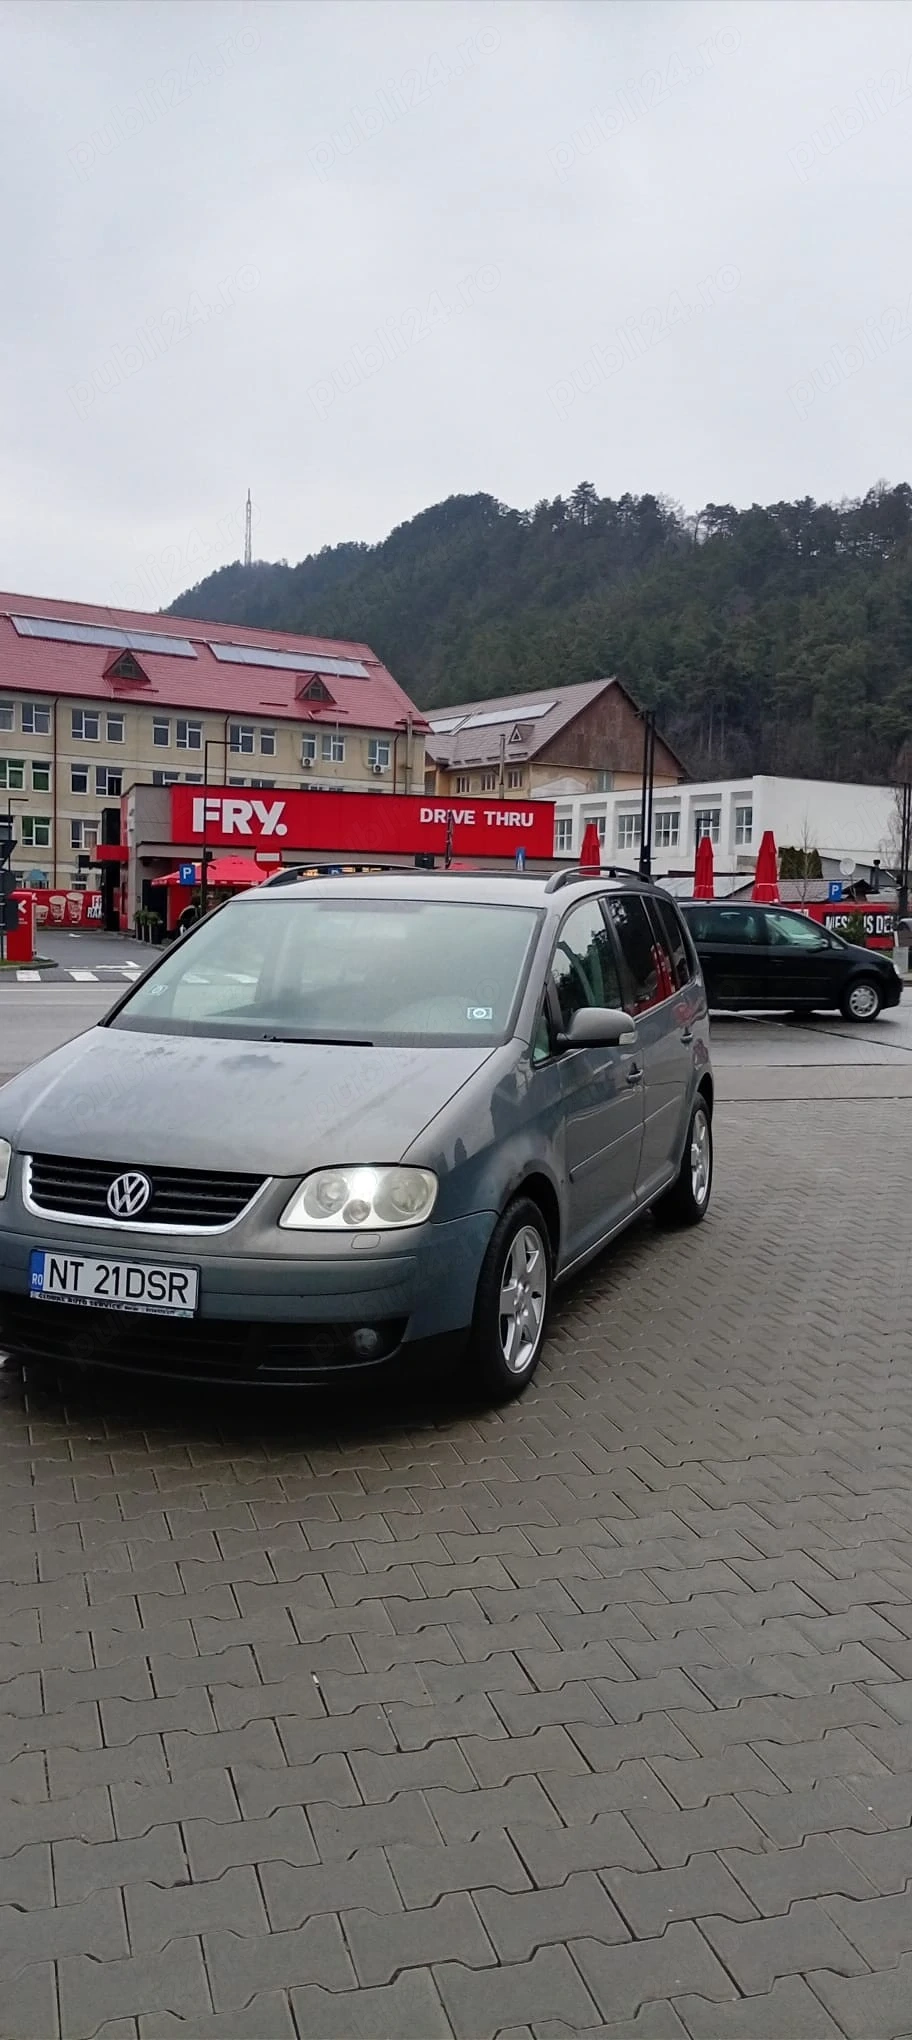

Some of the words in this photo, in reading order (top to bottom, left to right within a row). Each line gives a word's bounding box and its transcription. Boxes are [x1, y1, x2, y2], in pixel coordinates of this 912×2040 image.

[484, 810, 534, 827] THRU
[183, 867, 192, 880] P
[832, 885, 839, 896] P
[826, 915, 851, 930] MES
[32, 1273, 43, 1286] RO
[49, 1258, 84, 1291] NT
